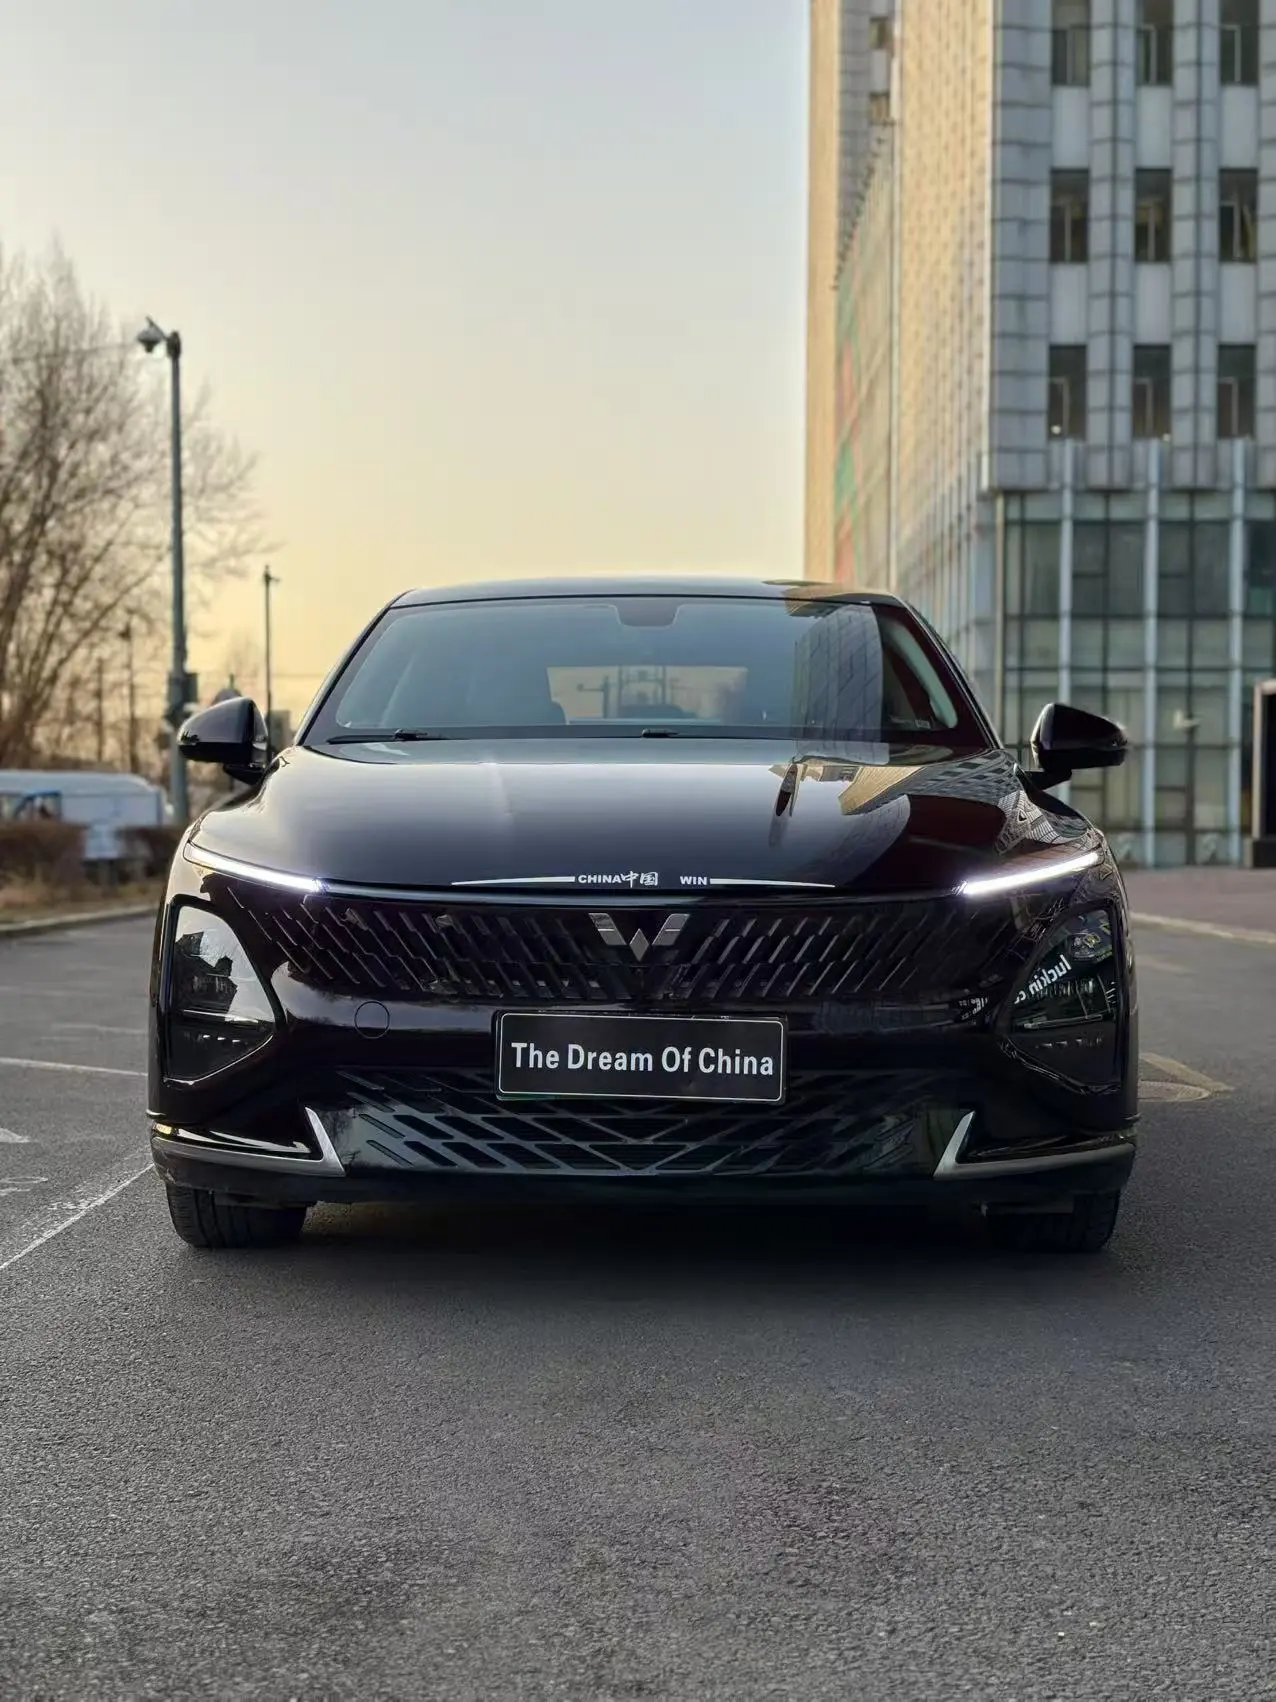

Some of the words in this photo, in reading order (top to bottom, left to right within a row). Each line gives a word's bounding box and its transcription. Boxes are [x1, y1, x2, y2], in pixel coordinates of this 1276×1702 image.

[680, 876, 707, 885] WIN
[511, 1042, 560, 1069] The
[567, 1044, 653, 1072] Dream
[661, 1046, 692, 1073] Of
[698, 1047, 774, 1076] China
